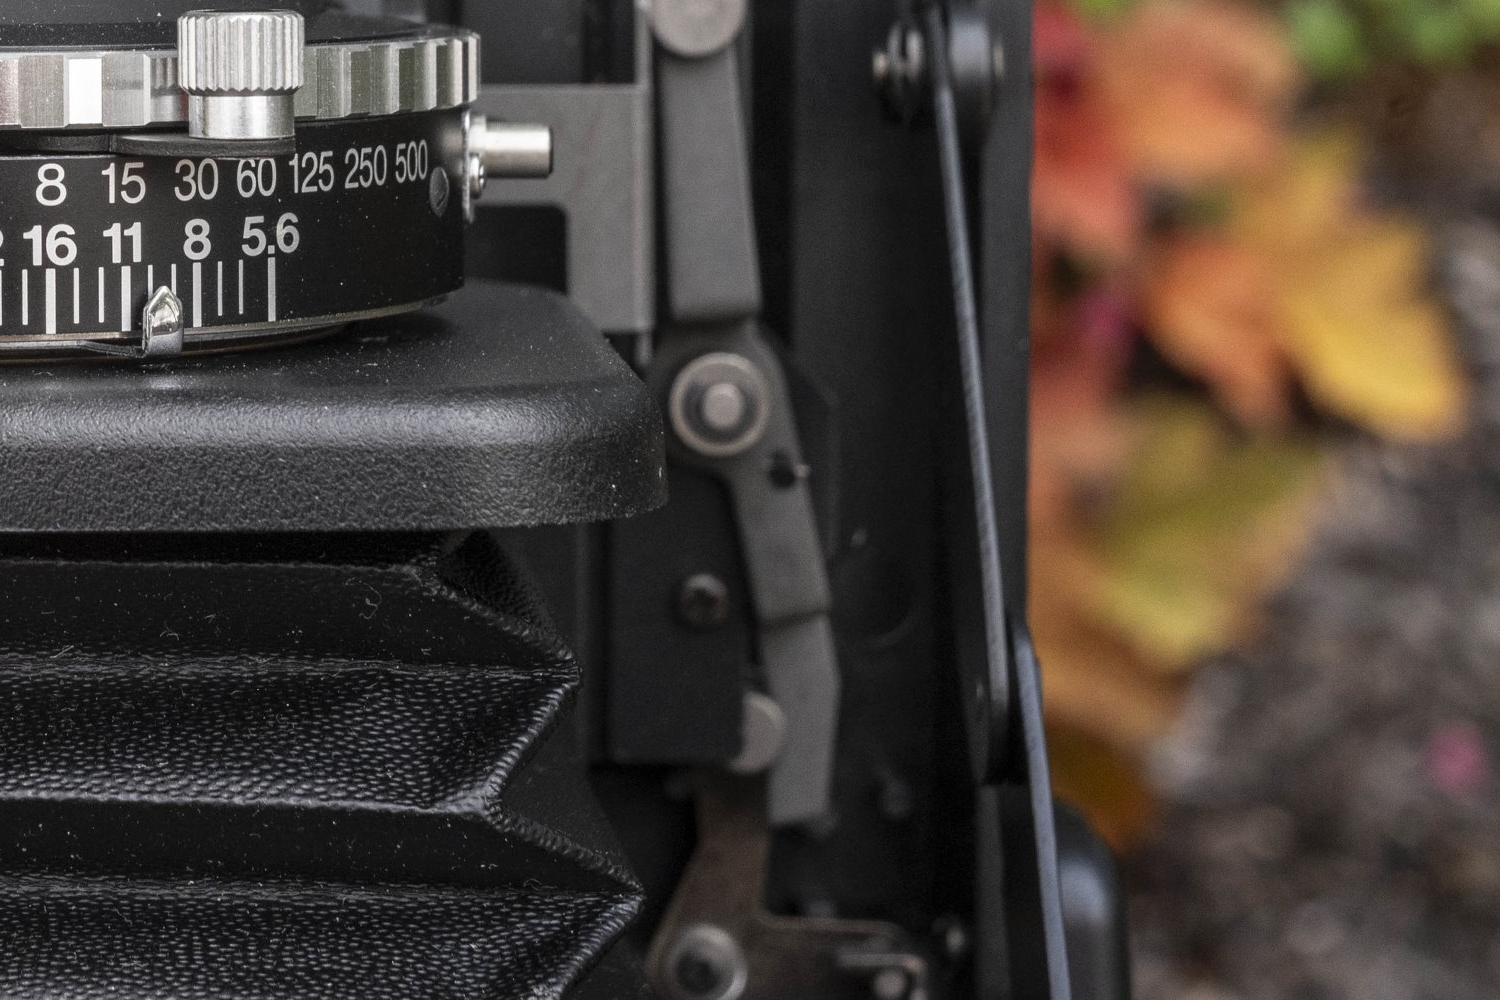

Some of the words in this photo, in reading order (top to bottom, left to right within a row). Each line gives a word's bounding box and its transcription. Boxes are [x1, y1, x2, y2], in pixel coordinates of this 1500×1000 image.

[35, 162, 68, 207] 8
[100, 161, 147, 205] 15
[174, 157, 219, 202] 30
[236, 156, 277, 198] 60
[288, 150, 335, 194] 125
[344, 143, 388, 189] 250
[395, 141, 428, 183] 500
[22, 223, 78, 267] 16
[102, 221, 143, 264] 11
[182, 218, 212, 261] 8
[241, 212, 300, 258] 5.6
